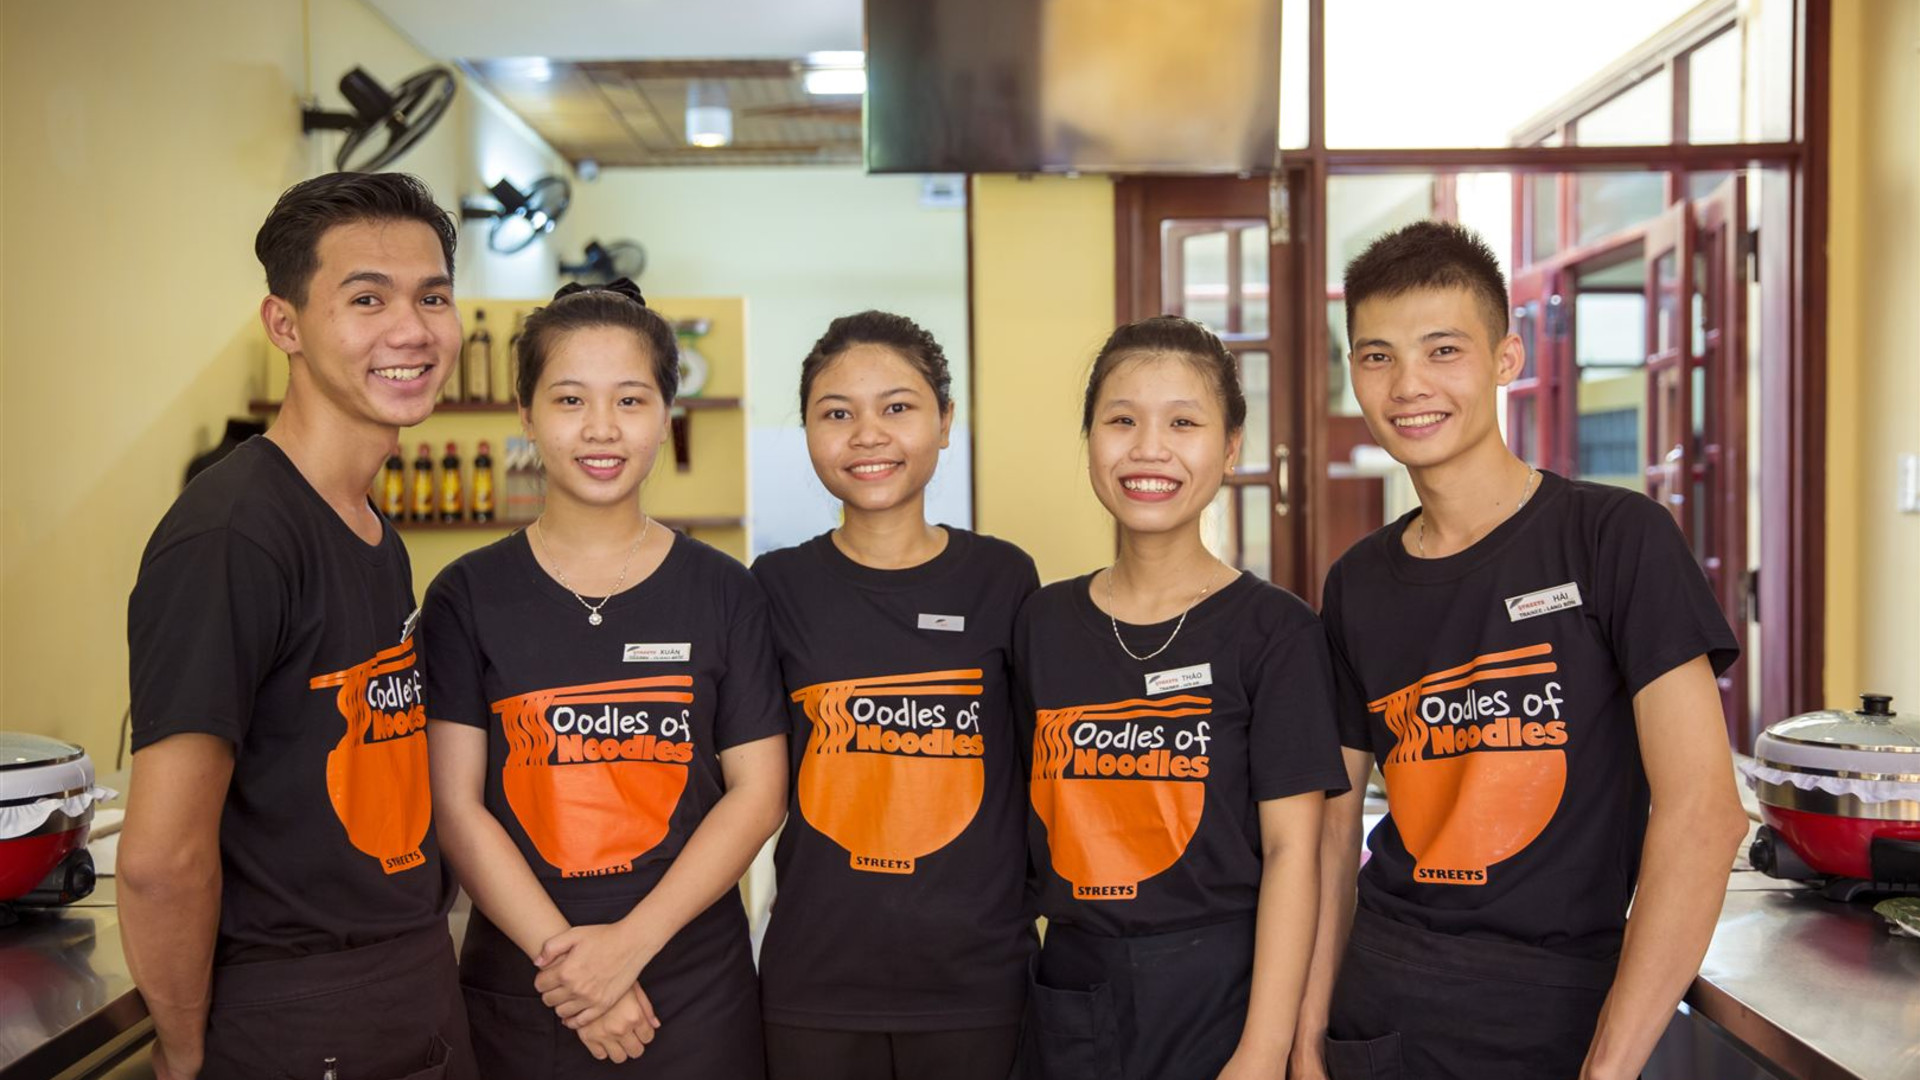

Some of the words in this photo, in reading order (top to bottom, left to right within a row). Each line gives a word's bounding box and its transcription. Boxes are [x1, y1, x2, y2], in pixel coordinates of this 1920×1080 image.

[853, 697, 946, 729] Oodles
[956, 701, 980, 733] of
[1421, 688, 1510, 724] Oodles
[1523, 682, 1564, 720] of
[553, 704, 649, 737] Oodles
[660, 709, 690, 742] of
[1074, 721, 1165, 751] Oodles
[1175, 721, 1211, 755] of
[1430, 717, 1568, 755] Noodles
[557, 734, 694, 763] Noodles
[857, 724, 984, 756] Noodles
[1074, 748, 1210, 778] Noodles
[856, 856, 911, 869] STREETS
[1419, 868, 1484, 881] STREETS
[1078, 885, 1135, 896] STREETS
